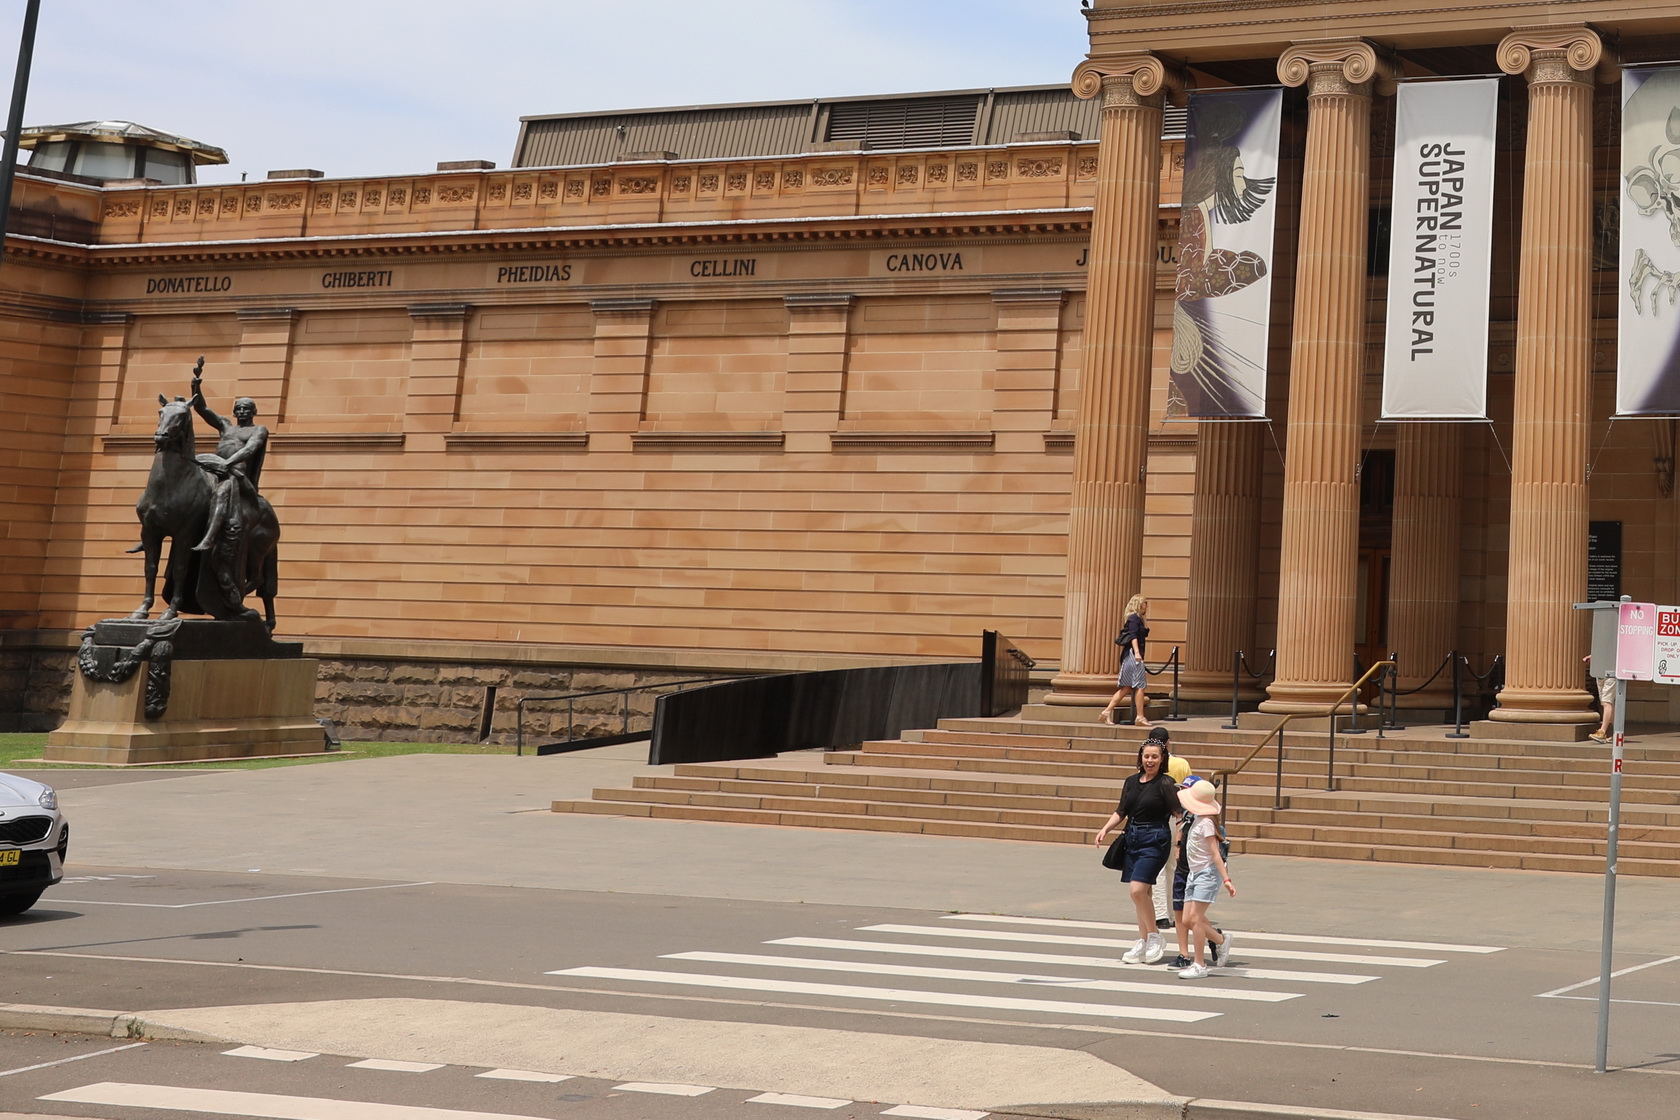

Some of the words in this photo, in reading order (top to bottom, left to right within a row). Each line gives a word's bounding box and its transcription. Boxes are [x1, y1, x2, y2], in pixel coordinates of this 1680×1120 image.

[1439, 143, 1466, 230] JAPAN
[1438, 234, 1449, 250] to
[1411, 143, 1443, 362] SUPERNATURAL
[1449, 234, 1461, 278] 1700s
[690, 259, 756, 277] CELLINI
[886, 253, 963, 271] CANOVA
[322, 271, 393, 288] GHIBERTI
[497, 265, 572, 283] PHEIDIAS
[1437, 258, 1446, 285] now
[146, 276, 231, 294] DONATELLO
[1630, 609, 1645, 620] NO
[1620, 624, 1654, 636] STOPPING
